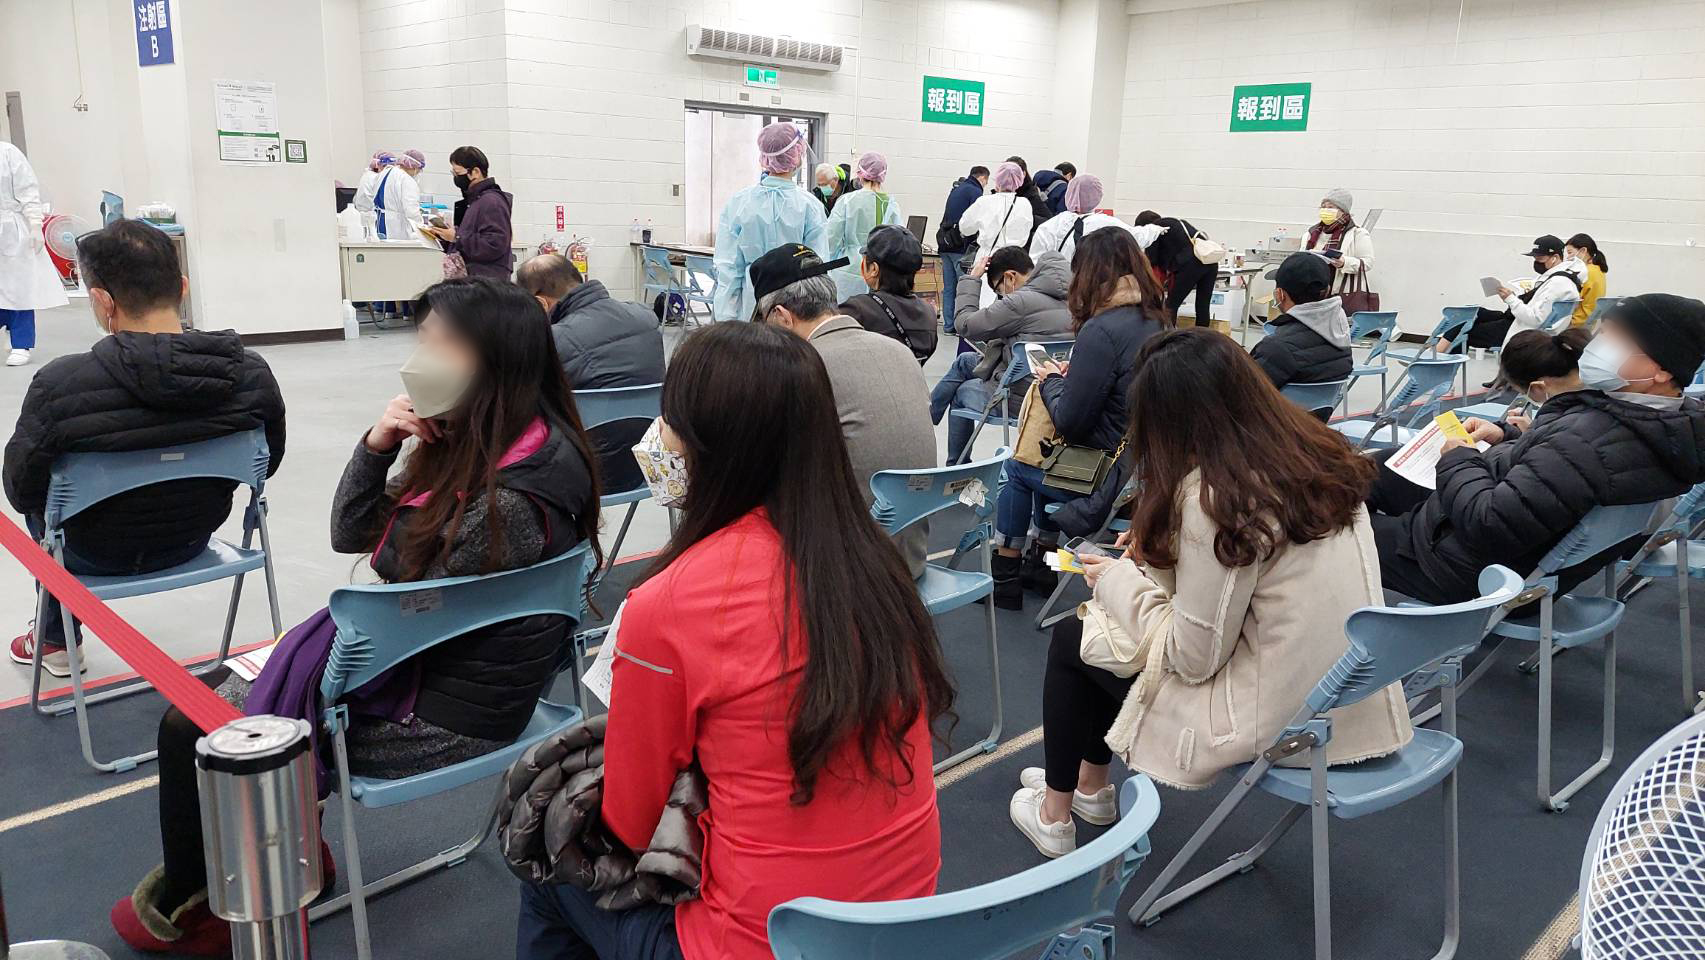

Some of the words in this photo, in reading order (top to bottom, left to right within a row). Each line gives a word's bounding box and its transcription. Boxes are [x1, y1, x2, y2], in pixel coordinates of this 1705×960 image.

[138, 1, 167, 32] 注射區
[151, 35, 159, 58] B
[927, 88, 981, 116] 報到區
[1237, 94, 1305, 121] 報到區
